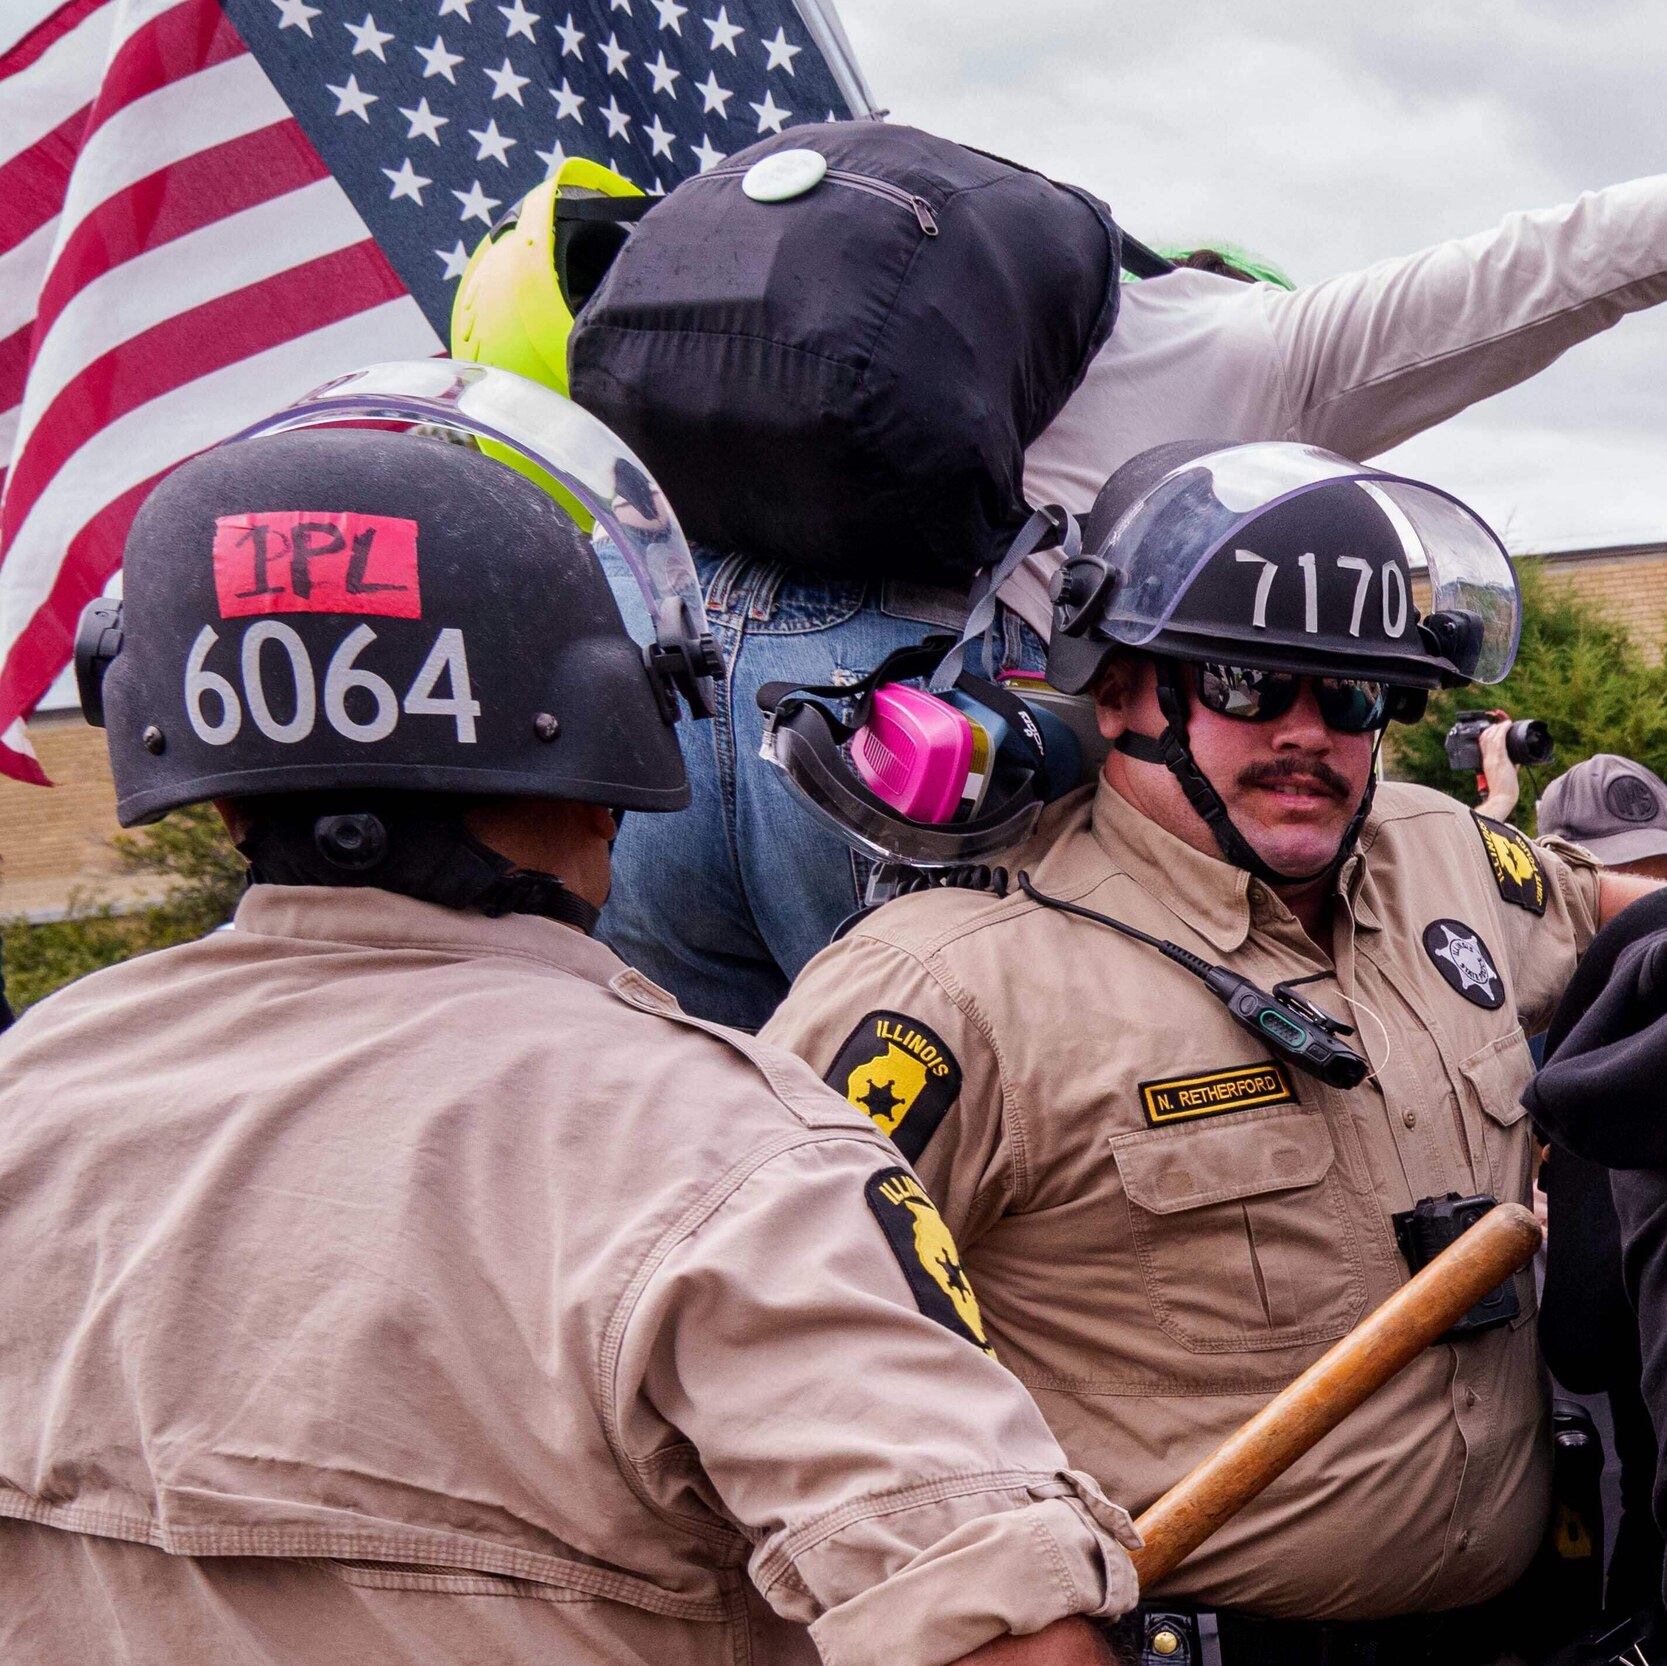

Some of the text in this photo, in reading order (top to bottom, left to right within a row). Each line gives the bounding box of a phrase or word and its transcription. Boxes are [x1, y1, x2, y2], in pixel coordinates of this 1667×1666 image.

[1235, 549, 1407, 639] 7170
[184, 619, 482, 746] 6064
[876, 1020, 949, 1077] ILLINOIS
[1157, 1075, 1276, 1112] N. RETHERFORD
